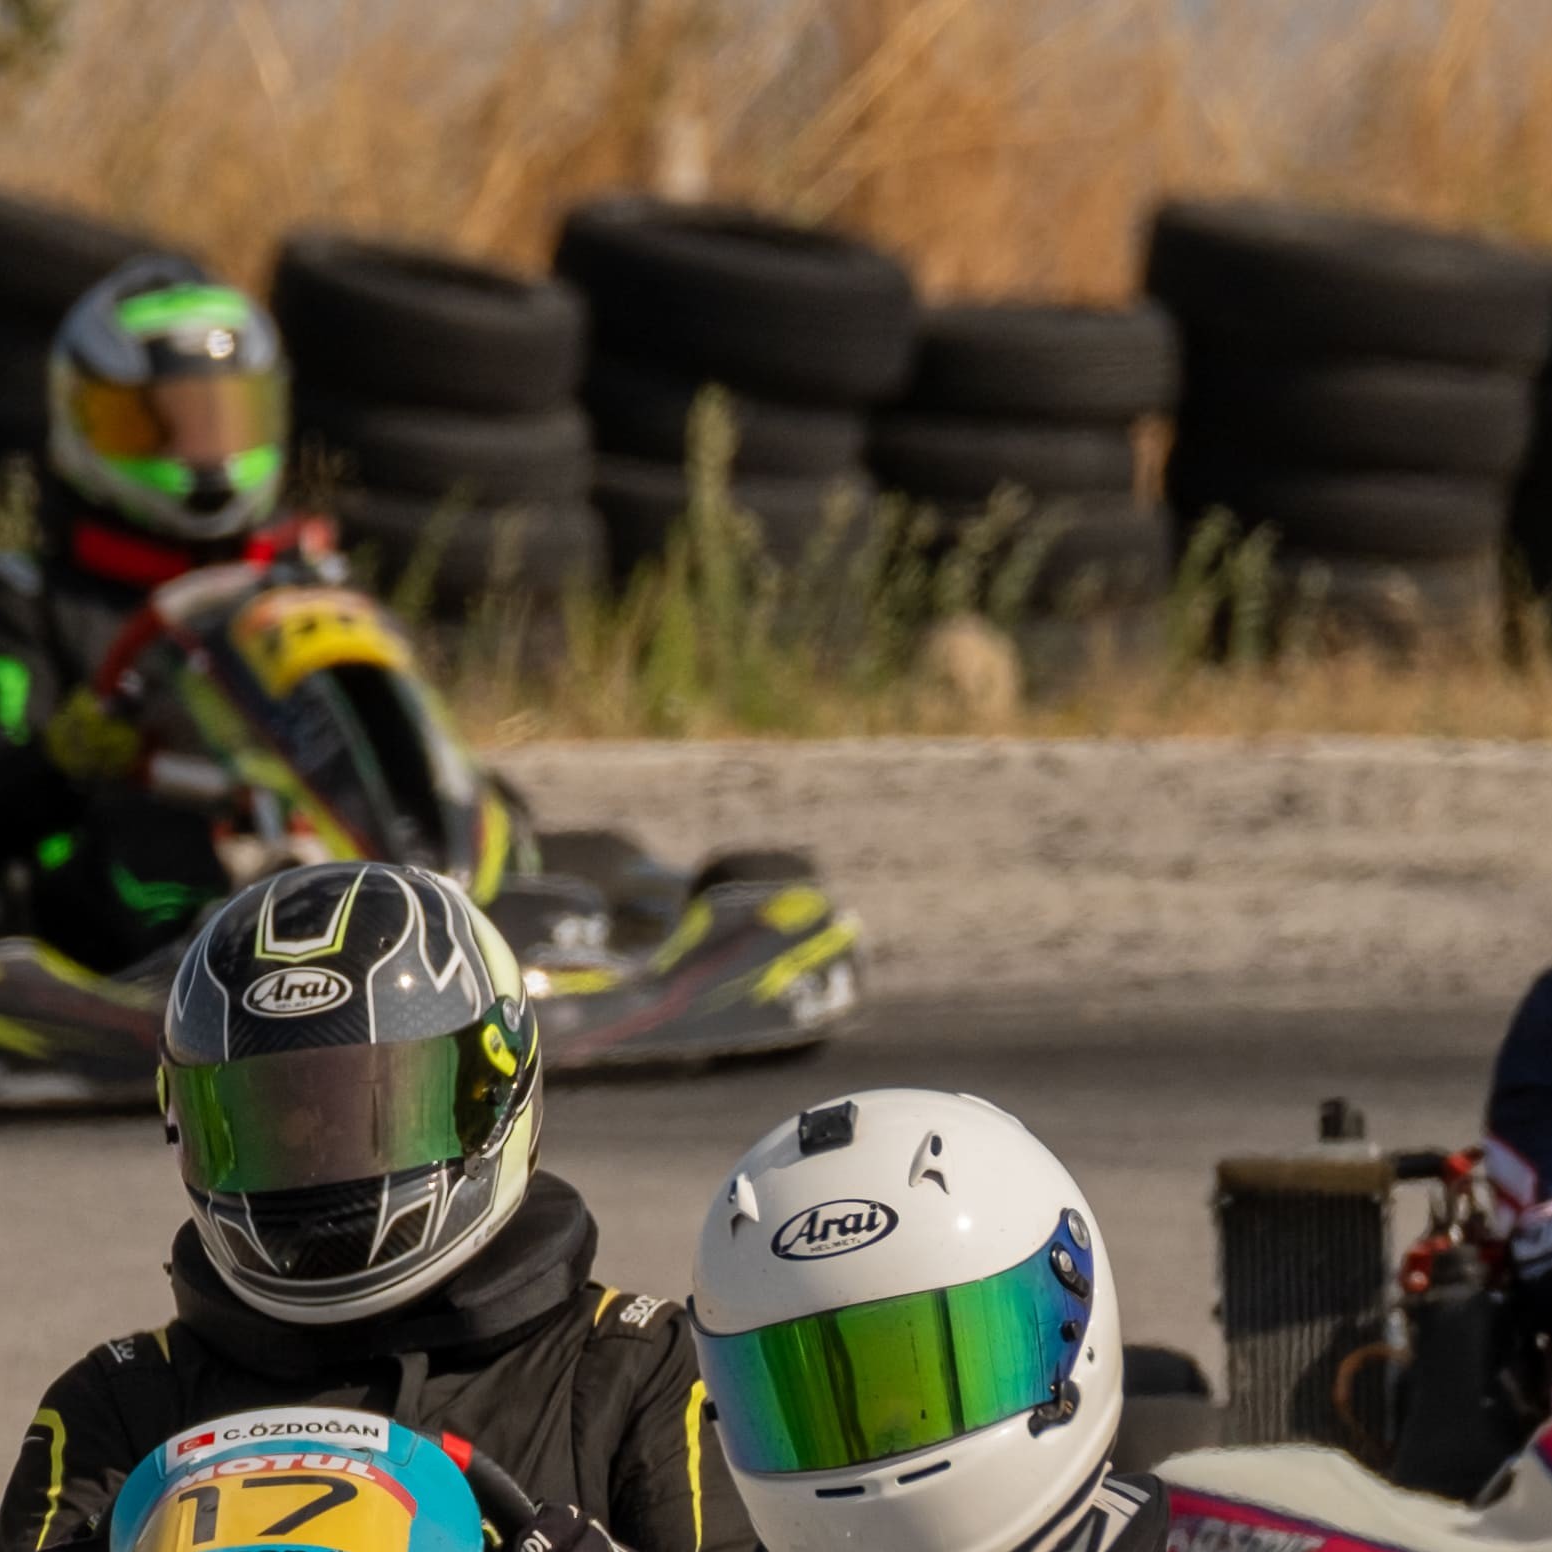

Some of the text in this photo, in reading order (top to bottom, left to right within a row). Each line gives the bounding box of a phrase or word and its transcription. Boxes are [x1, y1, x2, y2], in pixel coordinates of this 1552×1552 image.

[251, 974, 333, 1006] Arai
[780, 1203, 882, 1253] Arai
[170, 1453, 377, 1493] MOTUL
[178, 1475, 358, 1546] 17
